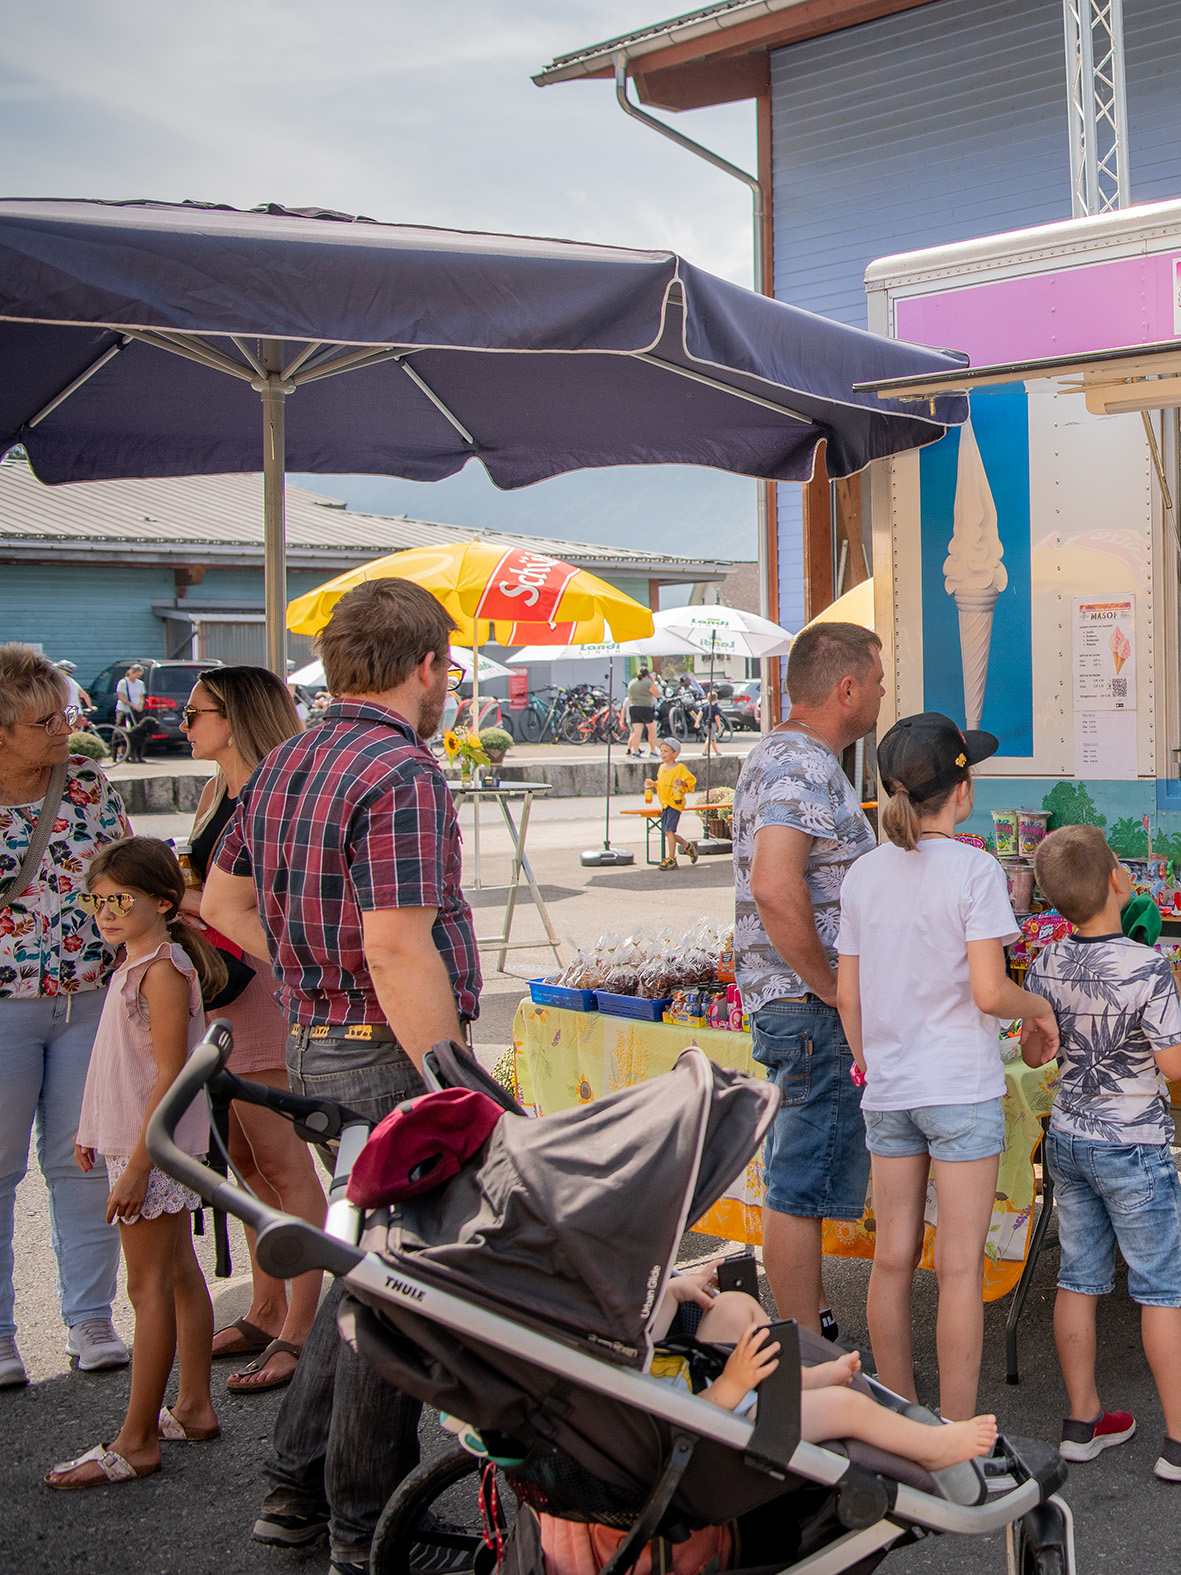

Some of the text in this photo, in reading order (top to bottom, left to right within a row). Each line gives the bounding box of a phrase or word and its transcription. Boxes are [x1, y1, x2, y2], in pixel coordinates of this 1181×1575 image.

[1090, 611, 1118, 620] MASOF
[691, 617, 729, 627] Landi
[580, 640, 620, 651] Landi
[385, 1275, 426, 1302] THULE
[640, 1264, 662, 1319] Urban Glide
